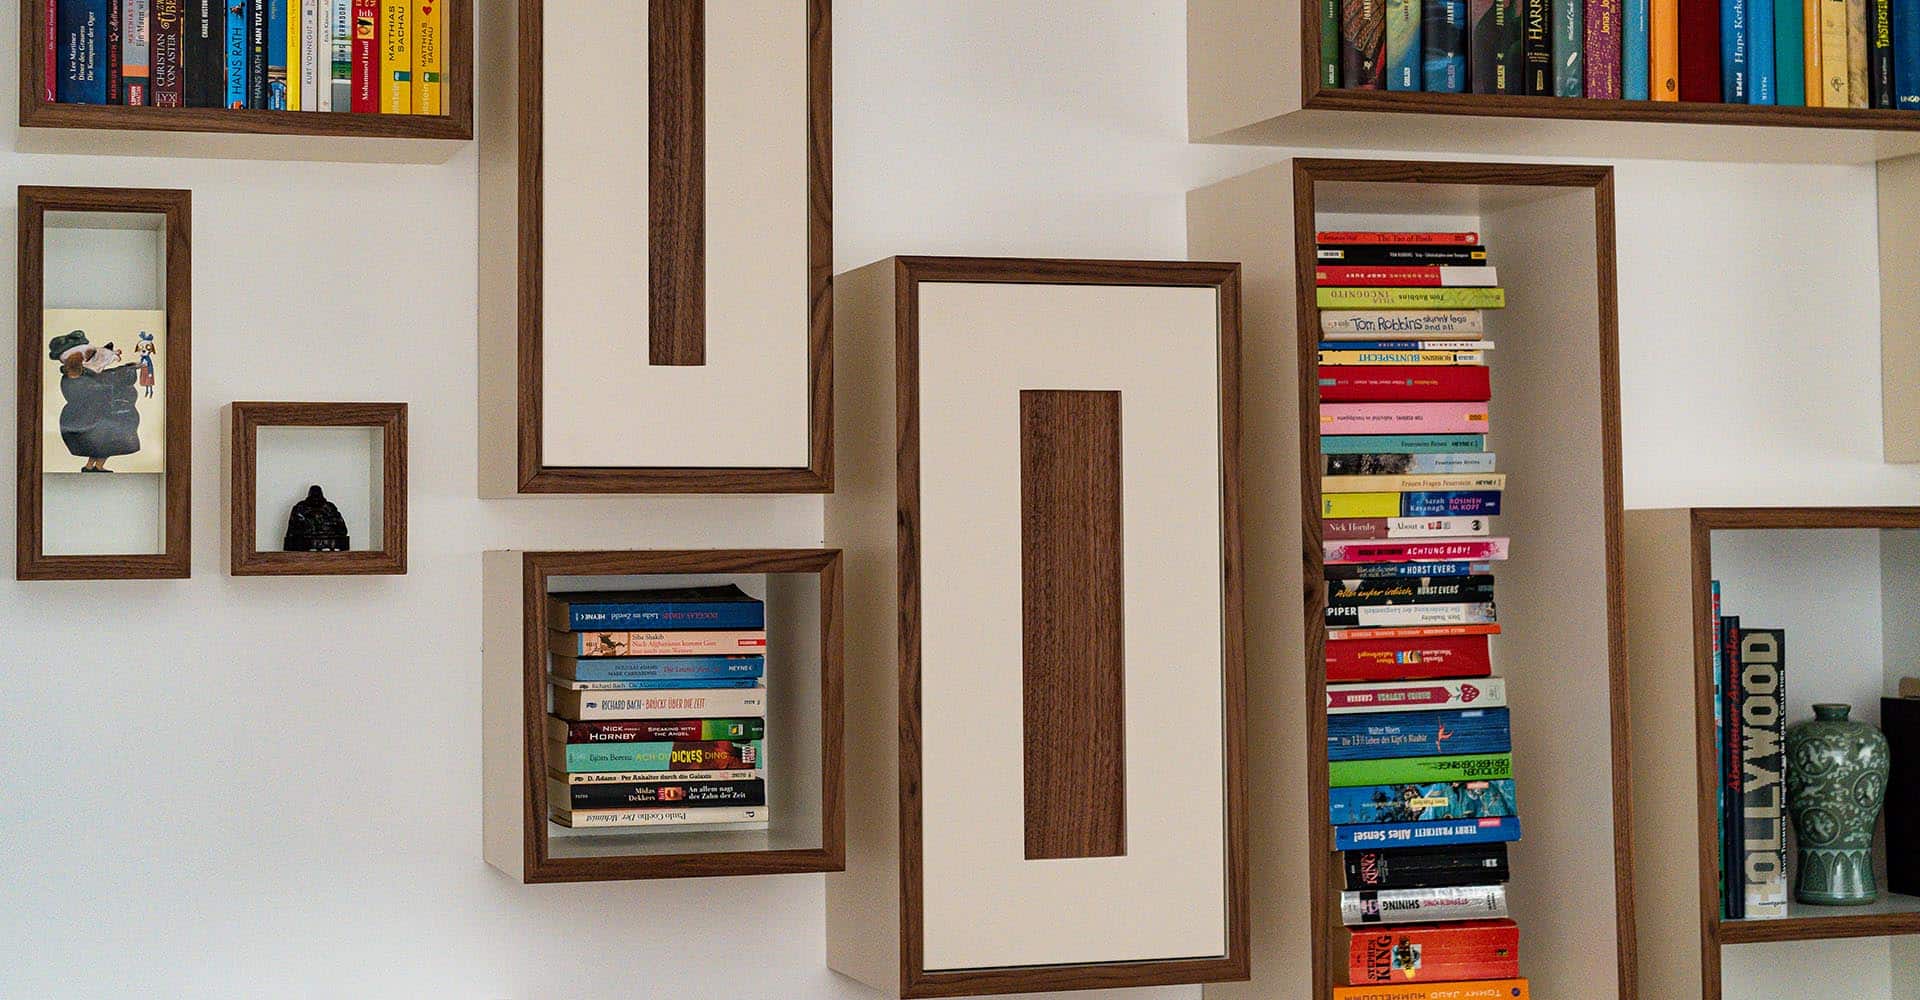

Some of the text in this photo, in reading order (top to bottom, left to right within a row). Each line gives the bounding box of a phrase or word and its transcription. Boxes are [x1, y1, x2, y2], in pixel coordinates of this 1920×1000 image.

[88, 10, 96, 27] Oger
[338, 2, 346, 41] HERRNDORF
[1600, 11, 1611, 35] Jonas
[135, 11, 145, 48] Ein Mann
[388, 5, 396, 61] MATTHIAS
[397, 5, 405, 52] SACHAU
[1733, 31, 1745, 64] Hape
[88, 38, 96, 70] Kompanie
[156, 32, 166, 87] CHRISTIAN
[167, 32, 177, 88] VON ASTER
[254, 11, 264, 99] HANS RATH MAN TUT,
[305, 25, 313, 86] KURT VONNEGUT
[231, 26, 243, 97] HANS RATH
[361, 39, 370, 101] Mohammed Hanif
[1496, 65, 1506, 90] CARLSEN
[1330, 289, 1390, 299] INCOGNITO
[1398, 293, 1445, 302] Tom Robbins
[1348, 316, 1376, 332] Tom
[1377, 316, 1424, 332] Robbins
[1423, 314, 1449, 324] skinny
[1442, 323, 1454, 331] all
[1359, 353, 1420, 362] BUNTSPECHT
[1410, 504, 1445, 512] Kavanagh
[1329, 522, 1376, 532] Nick Hornby
[1396, 522, 1416, 530] About
[1406, 547, 1445, 556] ACHTUNG
[1446, 545, 1471, 554] BABY!
[1406, 564, 1431, 575] HORST
[1433, 563, 1456, 574] EVERS
[1335, 586, 1414, 598] Alles irdisch
[1416, 584, 1459, 596] HORST EVERS
[584, 613, 606, 621] HEYNE
[610, 611, 659, 622] Lachs Zweifel
[1326, 606, 1358, 617] PIPER
[632, 633, 665, 641] Siba Shakib
[1423, 656, 1444, 664] Haruki
[663, 664, 674, 672] Die
[728, 664, 747, 672] HEYNE
[1346, 694, 1374, 703] CARAVAN
[1778, 669, 1786, 720] COLLECTION
[601, 699, 626, 711] RICHARD
[626, 699, 642, 710] BACH
[667, 697, 683, 709] ÜBER
[683, 697, 692, 709] DIE
[692, 697, 705, 709] ZEIT
[1726, 627, 1742, 793] Abenteuer Amerika
[647, 725, 680, 733] SPEAKING
[1368, 726, 1384, 735] Walter
[589, 732, 637, 741] HORNBY
[1342, 737, 1351, 746] Die
[1365, 736, 1380, 745] Leben
[671, 749, 703, 764] DICKES
[704, 752, 728, 761] DING
[1437, 758, 1510, 770] DER HERR DER RINGE
[632, 773, 659, 781] Anhalter
[1741, 629, 1784, 916] HOLLYWOOD
[635, 787, 656, 795] Midas
[719, 786, 734, 795] nagt
[719, 792, 731, 800] der
[731, 791, 746, 799] Zeit
[628, 794, 656, 802] Dekkers
[586, 812, 687, 823] Paulo Coelho Der Alchimist
[1353, 825, 1477, 843] TERRY PRATCHETT Alles Sense!
[1365, 852, 1379, 885] KING
[1382, 898, 1421, 911] SHINING
[1367, 939, 1376, 980] STEPHEN
[1375, 934, 1392, 981] KING
[1430, 988, 1502, 1000] TOMMY JAUD
